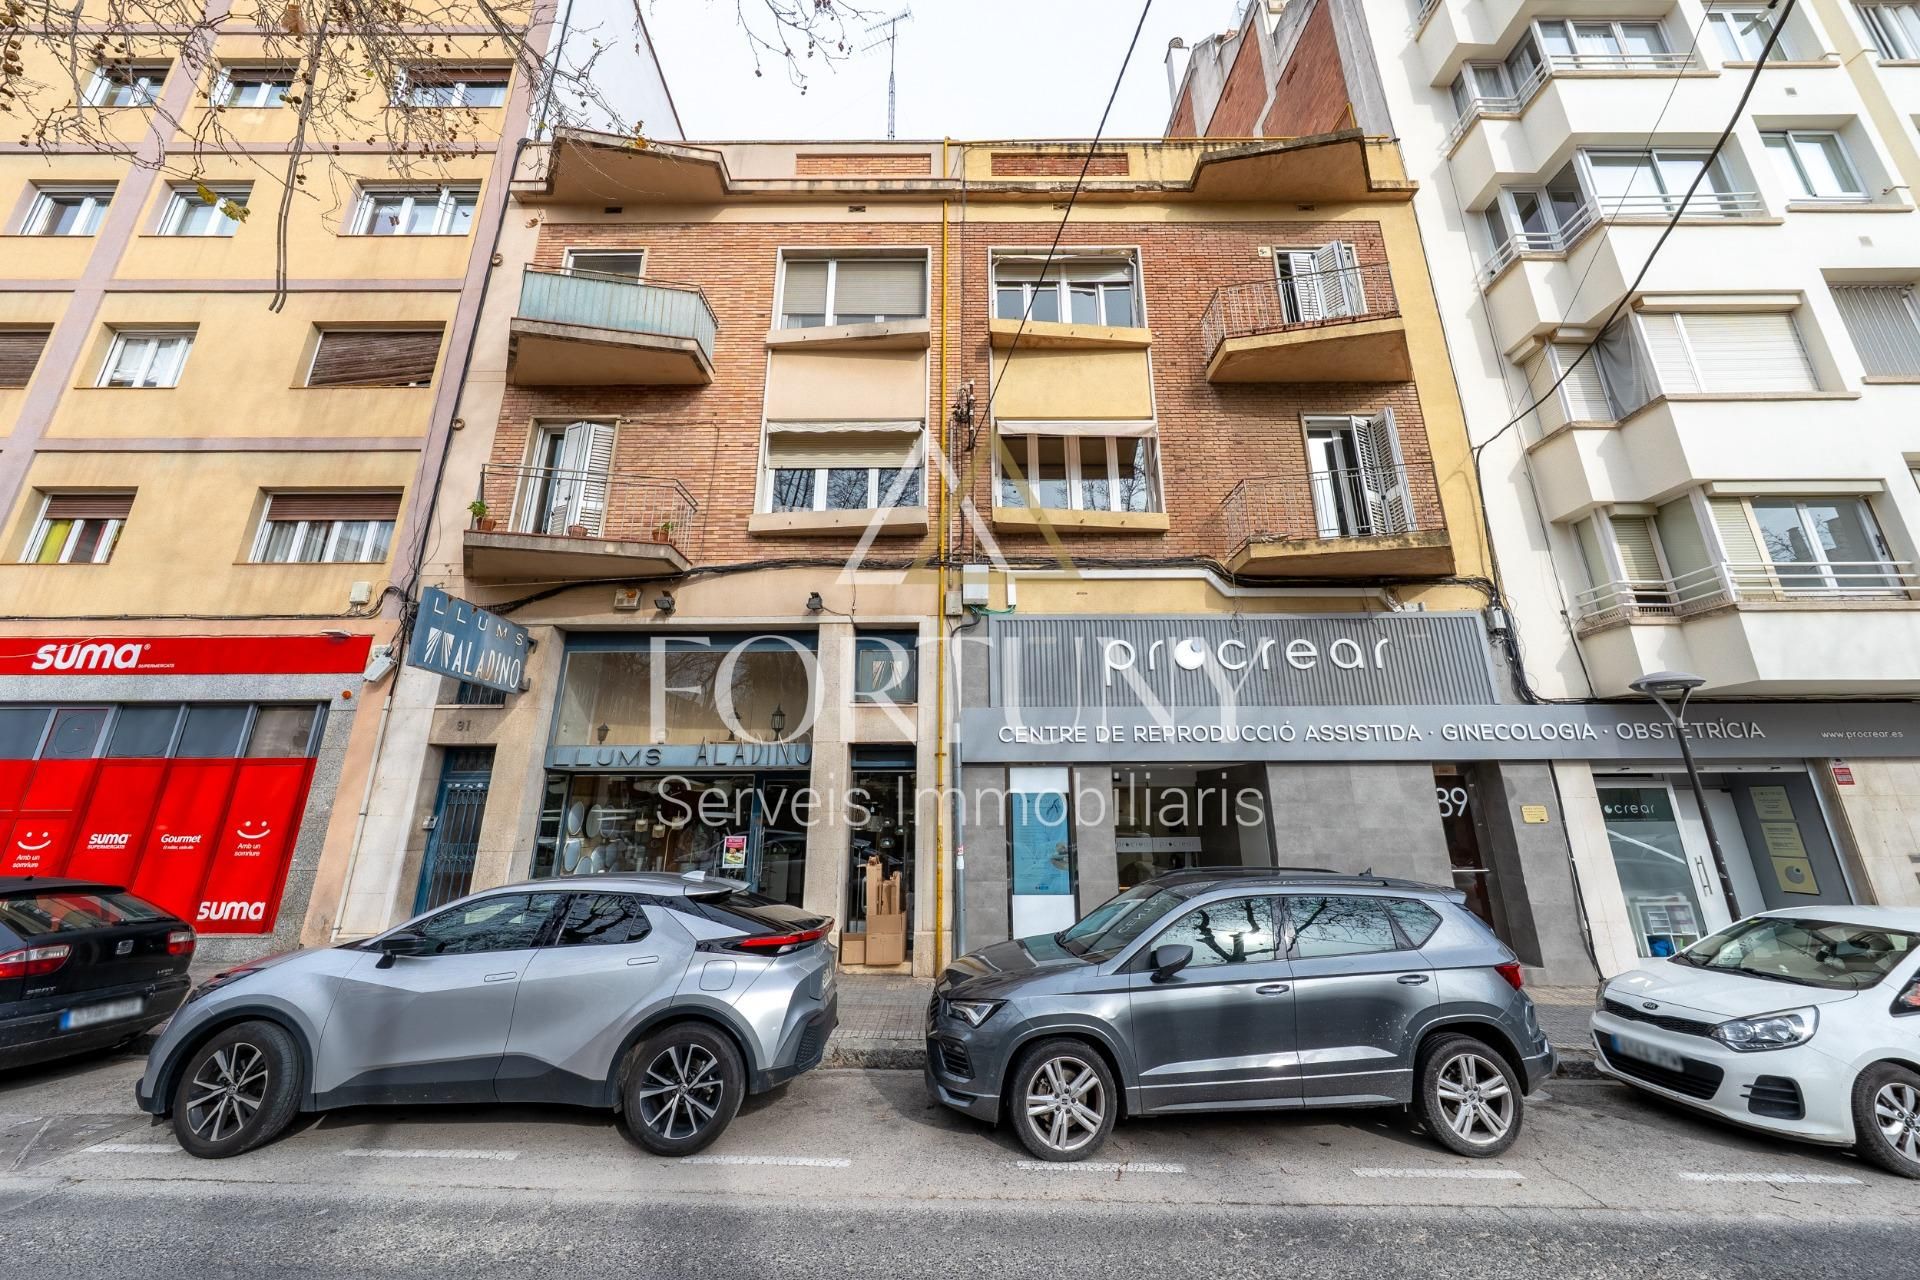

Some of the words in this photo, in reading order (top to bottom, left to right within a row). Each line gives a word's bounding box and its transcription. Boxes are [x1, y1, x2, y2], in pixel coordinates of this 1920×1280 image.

[434, 597, 525, 647] LLUMS
[451, 640, 522, 689] ALADINO
[1105, 637, 1389, 687] procrear
[998, 725, 1088, 743] CENTRE
[1095, 725, 1126, 743] DE
[1132, 720, 1296, 743] REPRODUCCIÓ
[1304, 724, 1423, 742] ASSISTIDA
[1440, 722, 1598, 742] GINECOLOGIA
[1820, 730, 1904, 740] www.procrear.es
[552, 748, 662, 767] LLUMS
[694, 735, 812, 766] ALADINO
[160, 833, 202, 843] Gourmet
[196, 900, 266, 920] suma
